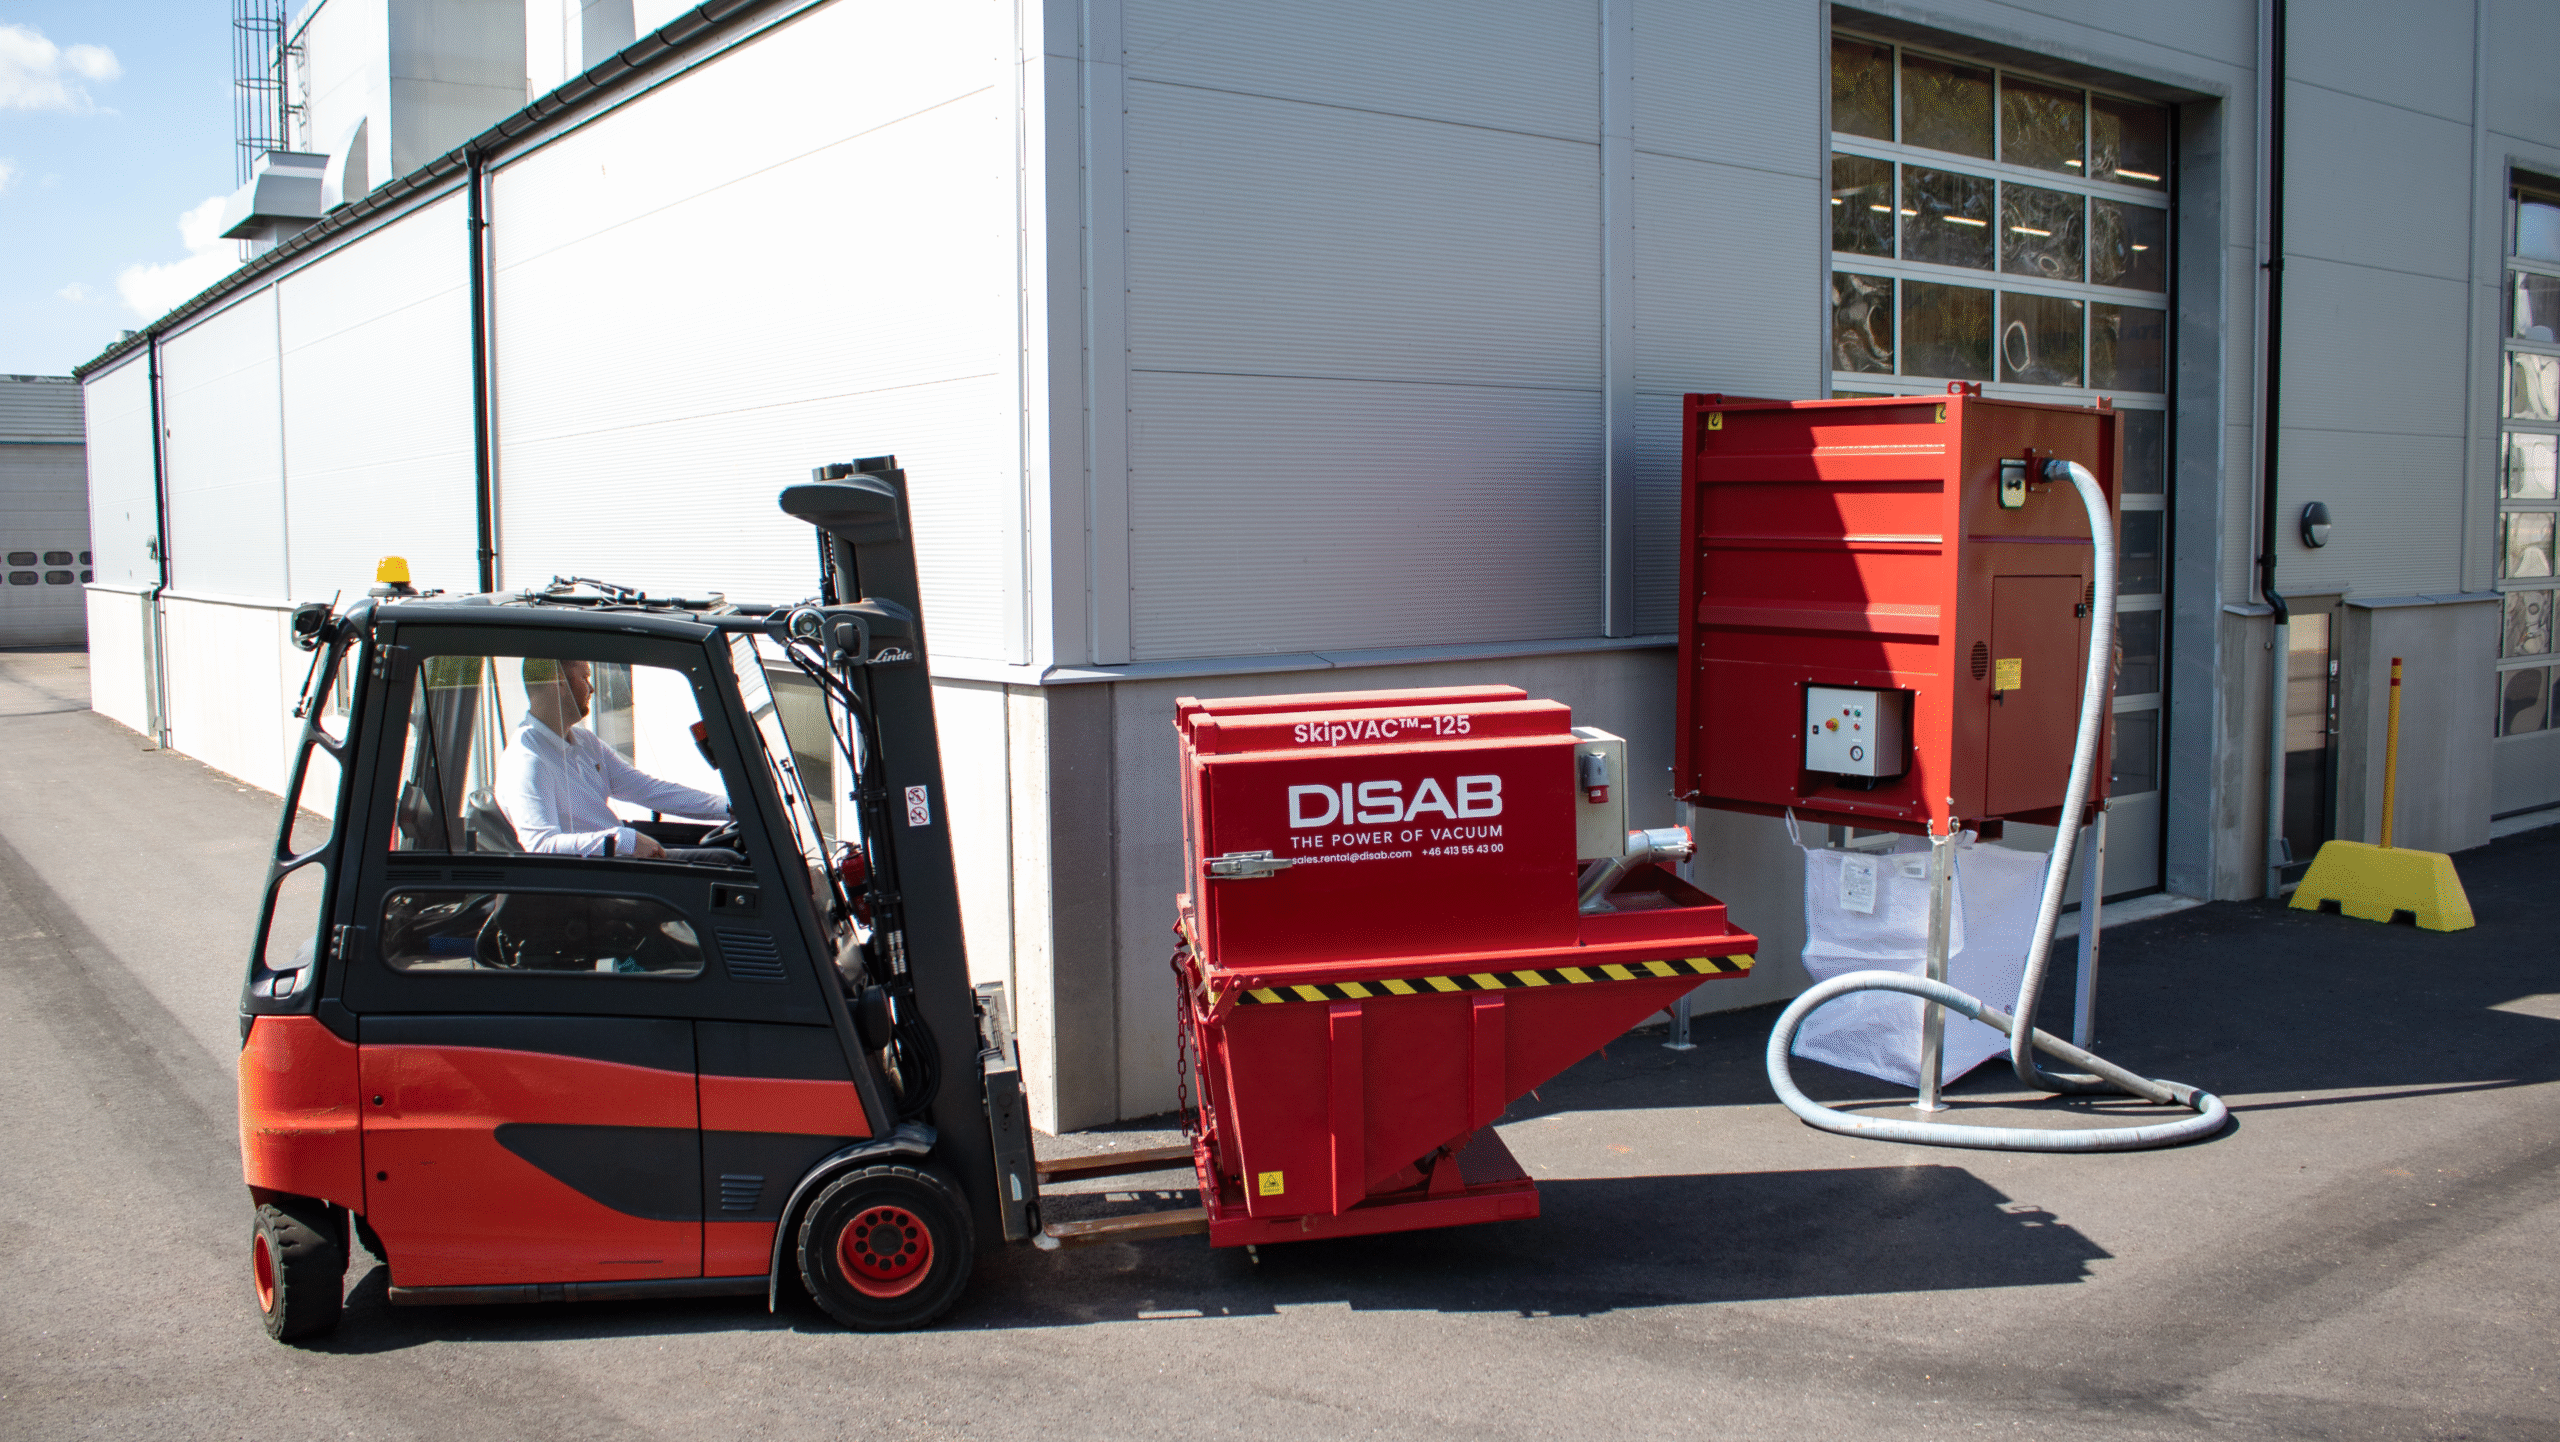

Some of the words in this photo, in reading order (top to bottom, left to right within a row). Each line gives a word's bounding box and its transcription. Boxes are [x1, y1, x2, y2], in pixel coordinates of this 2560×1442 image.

[865, 646, 913, 664] Linde
[1288, 775, 1503, 829] DISAB
[1290, 836, 1323, 849] THE
[1332, 831, 1393, 847] POWER
[1401, 830, 1424, 842] OF
[1431, 825, 1503, 840] VACUUM
[1422, 846, 1441, 857] +46
[1443, 845, 1459, 856] 413
[1461, 844, 1475, 855] 55
[1476, 844, 1489, 854] 43
[1491, 843, 1504, 853] 00
